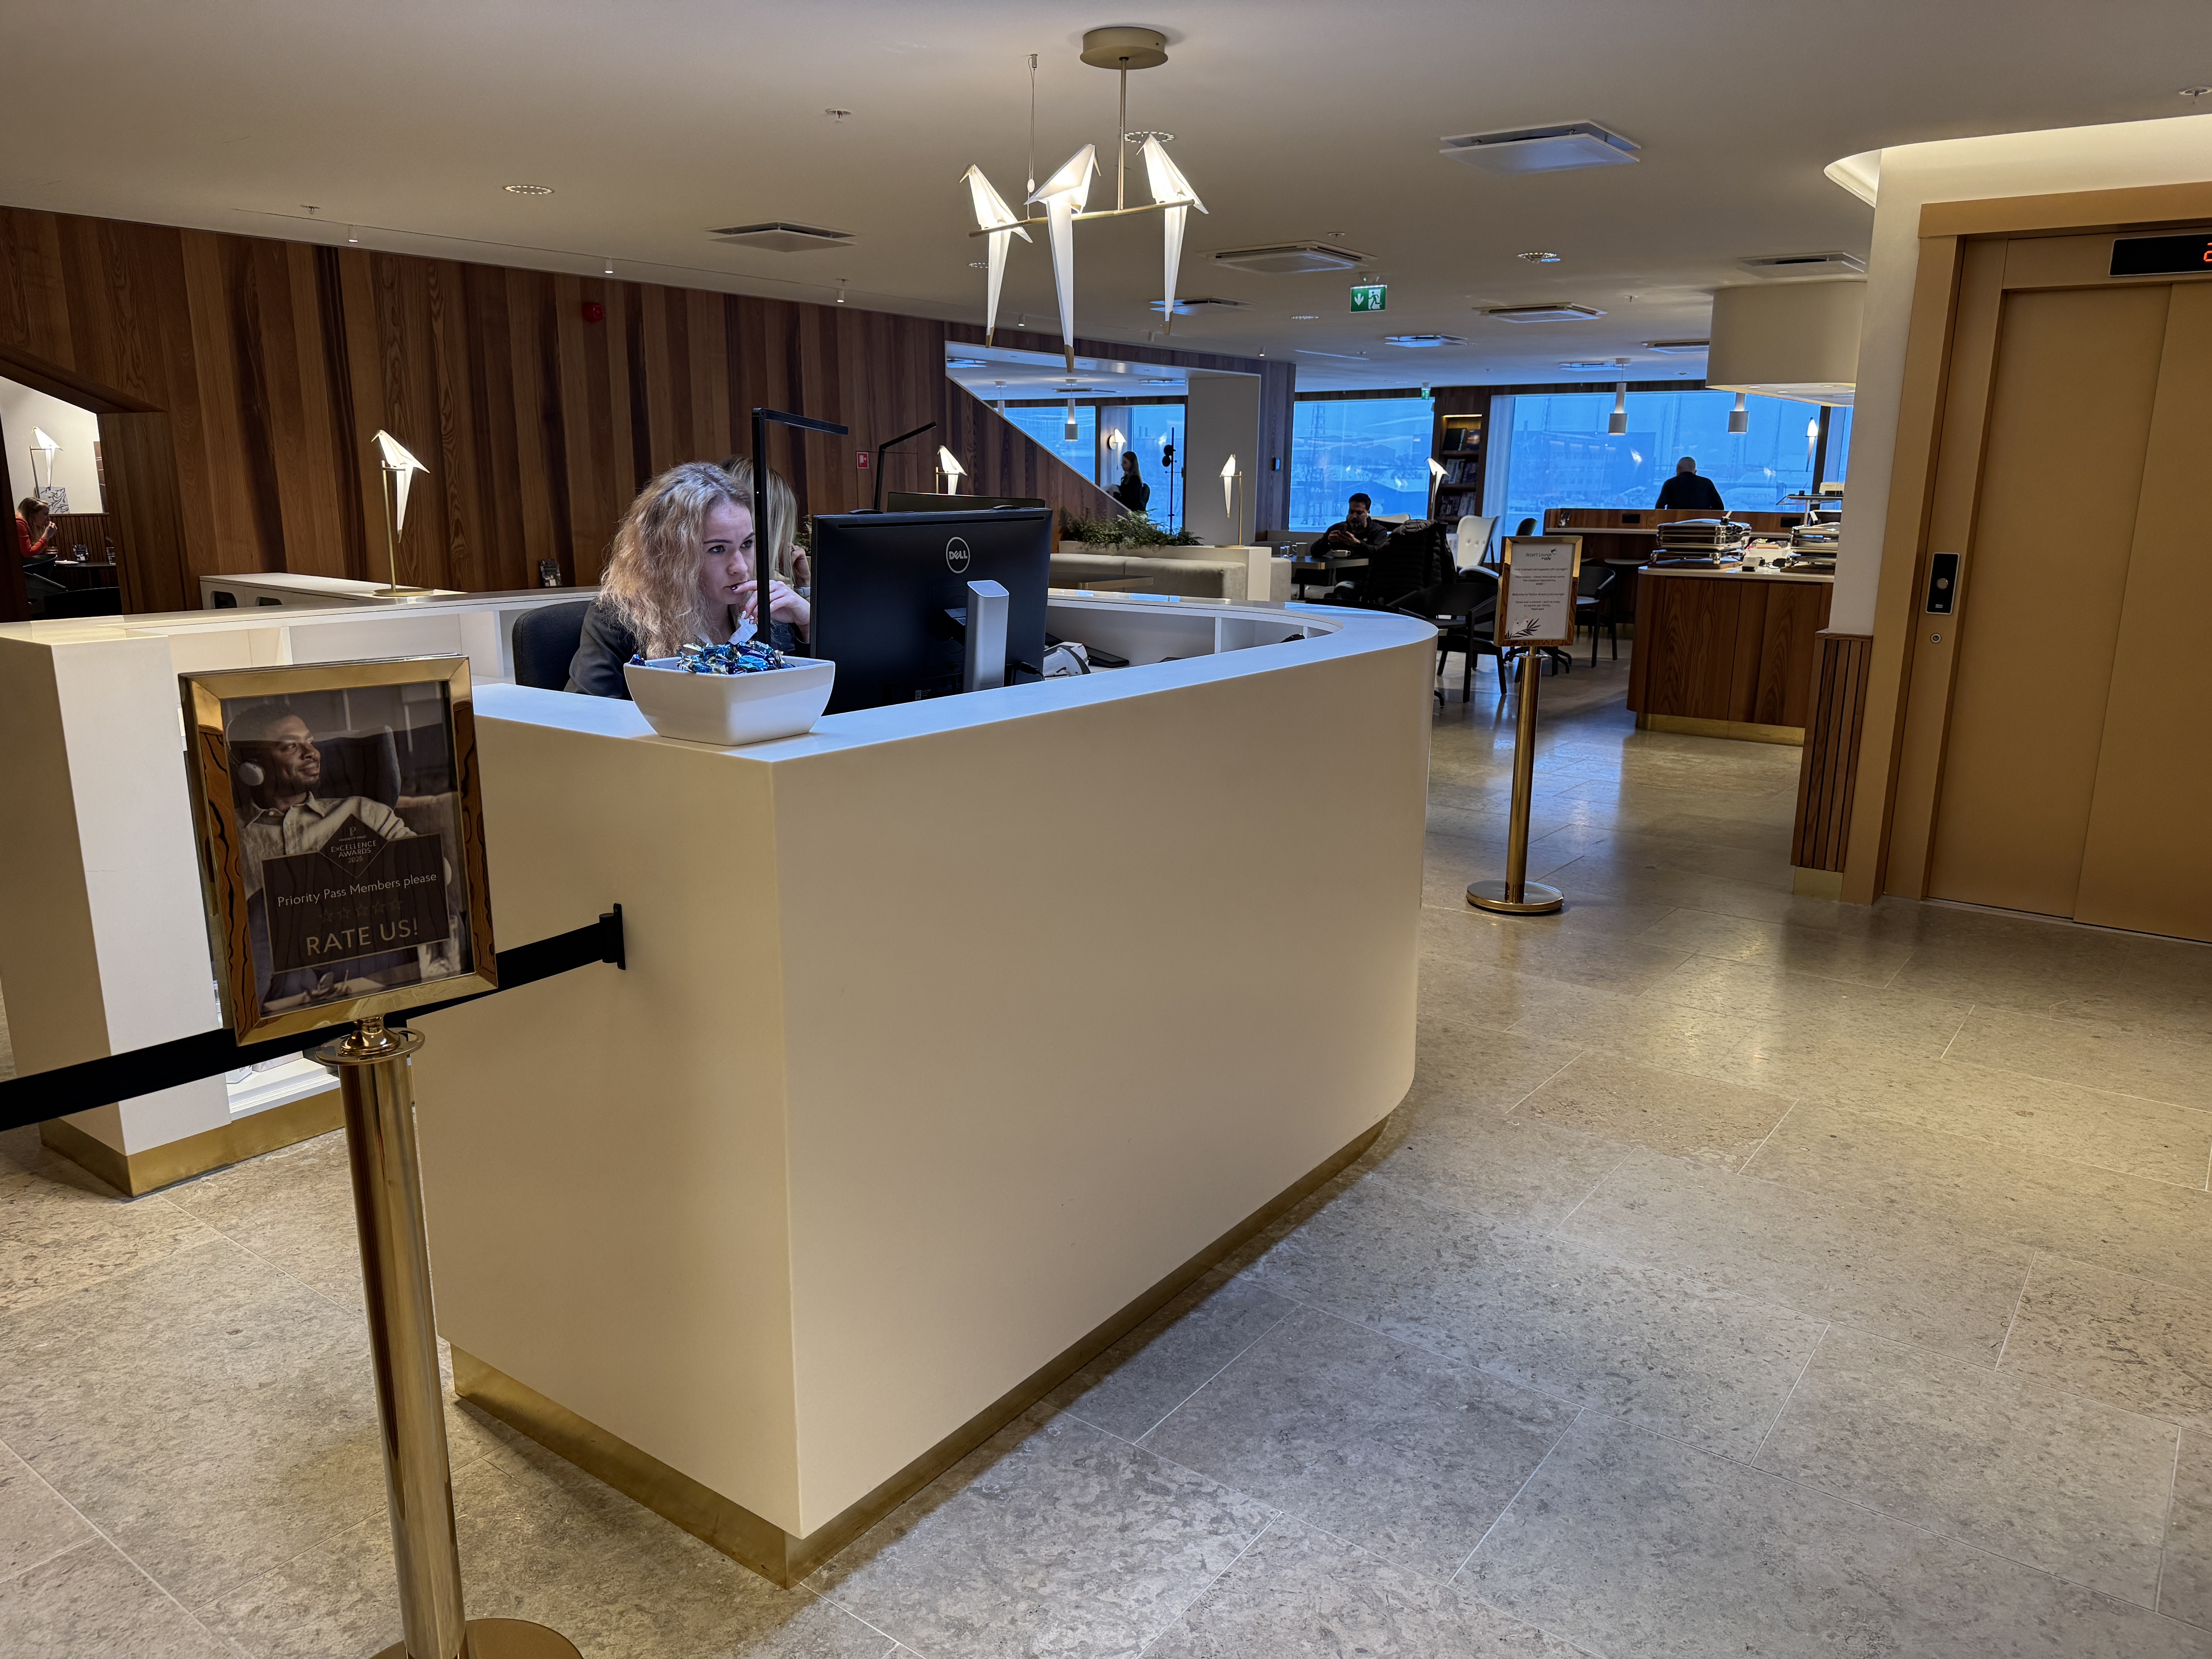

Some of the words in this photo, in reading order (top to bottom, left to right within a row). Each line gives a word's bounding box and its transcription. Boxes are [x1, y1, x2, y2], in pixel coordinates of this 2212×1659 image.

[948, 550, 968, 560] DELL
[331, 840, 377, 852] EXCELLENCE
[338, 848, 371, 858] AWARDS
[278, 893, 320, 907] Priority
[324, 889, 347, 900] Pass
[350, 880, 401, 895] Members
[404, 874, 437, 889] please
[306, 926, 371, 956] RATE
[380, 917, 418, 941] US!
